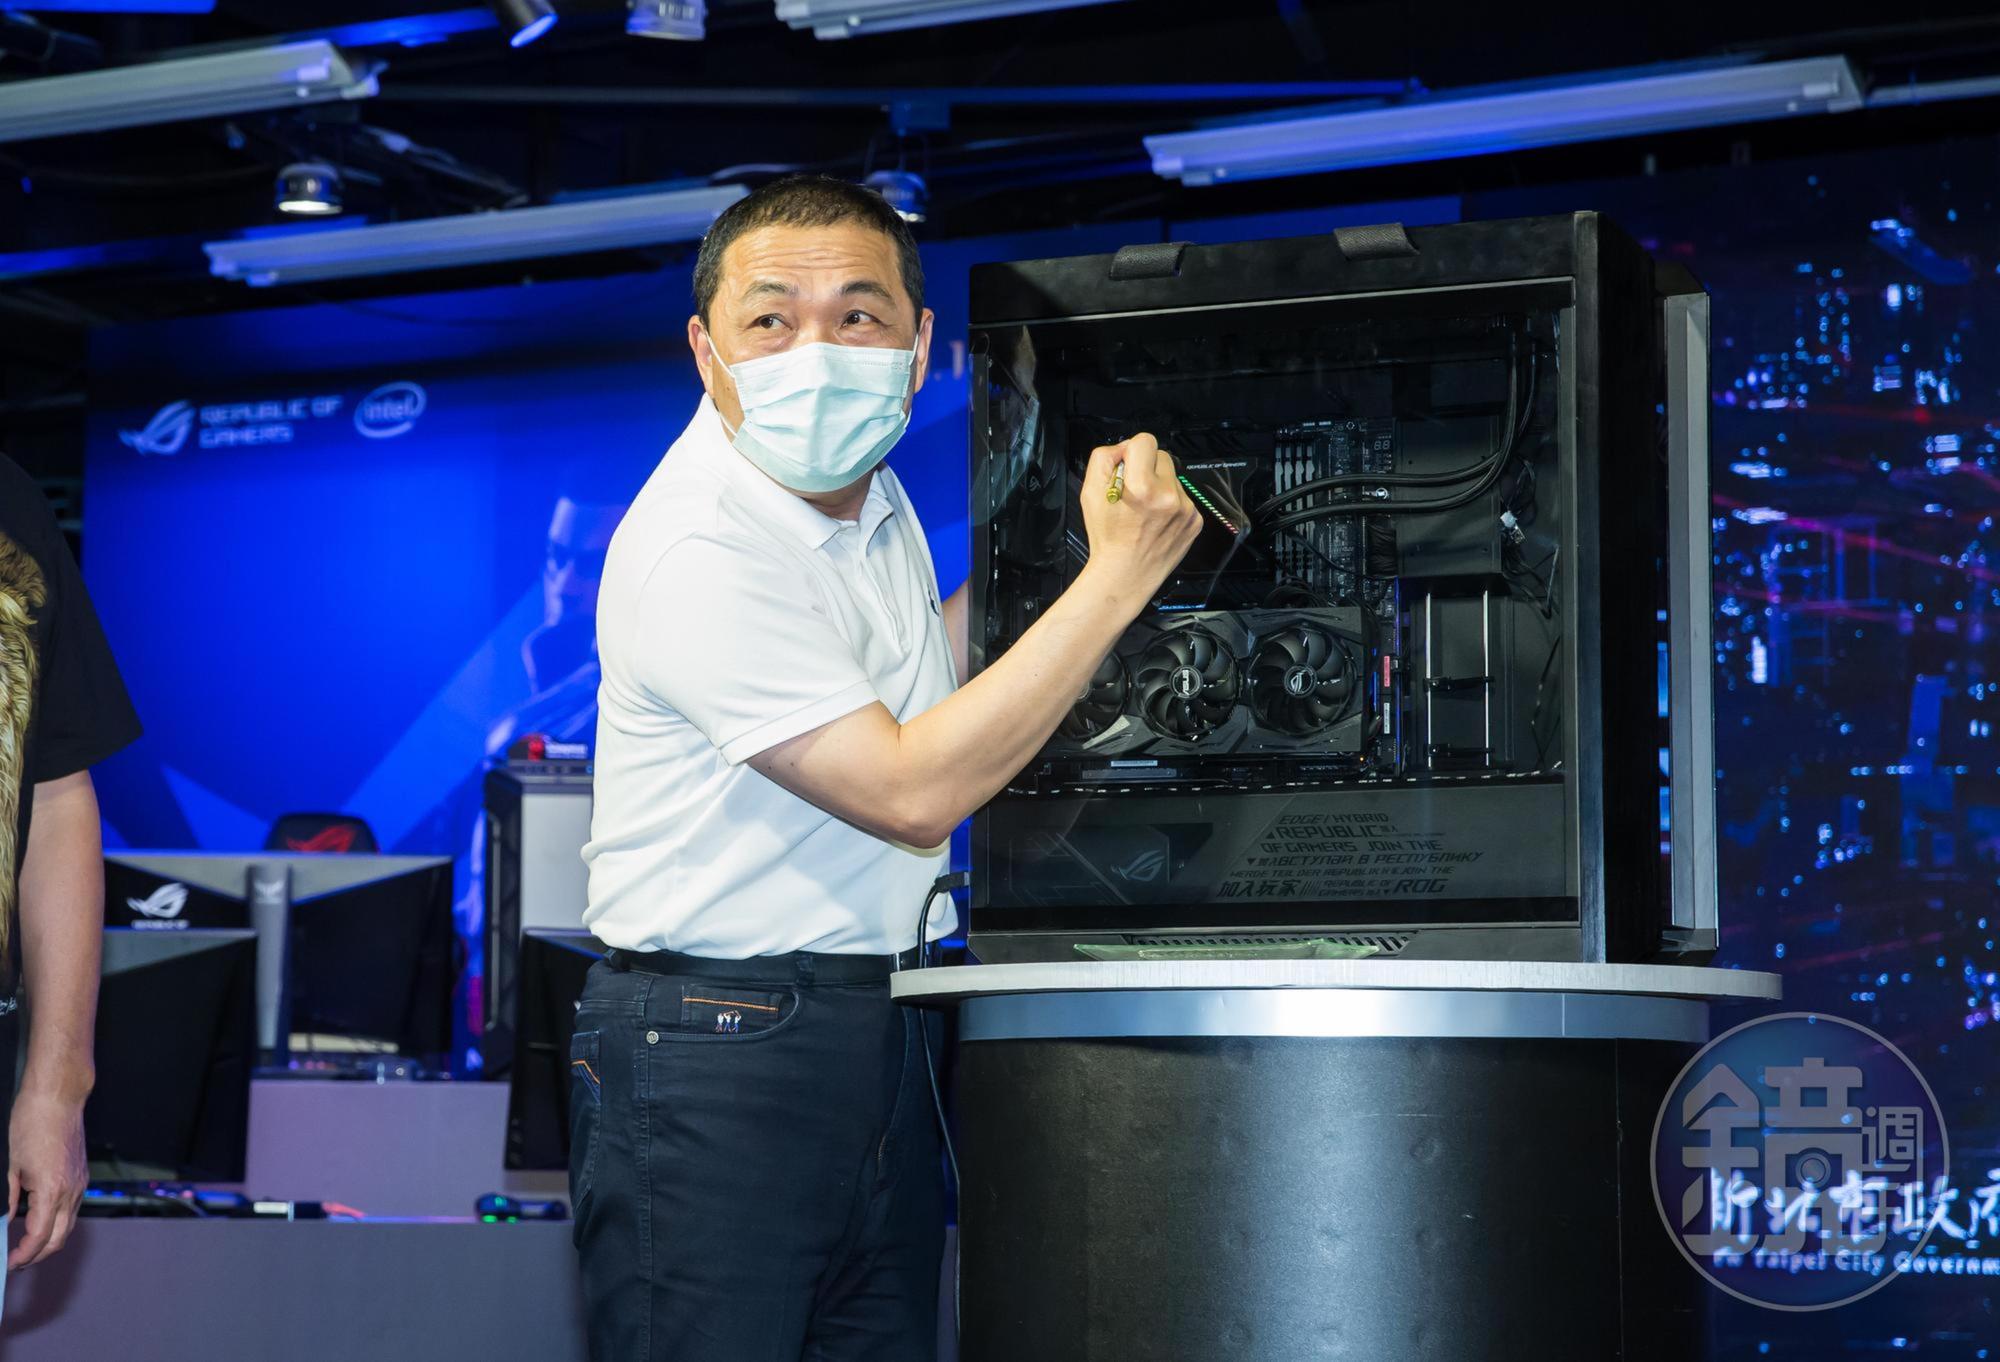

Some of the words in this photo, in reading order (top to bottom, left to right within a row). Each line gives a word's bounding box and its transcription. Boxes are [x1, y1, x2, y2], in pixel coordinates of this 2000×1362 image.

[1275, 825, 1383, 839] REPUBLIC
[1260, 842, 1283, 853] OF
[1285, 841, 1358, 853] GAMERS
[1367, 840, 1402, 851] JOIN
[1405, 839, 1443, 851] THE
[1393, 878, 1449, 893] ROG
[1834, 1248, 1886, 1276] City
